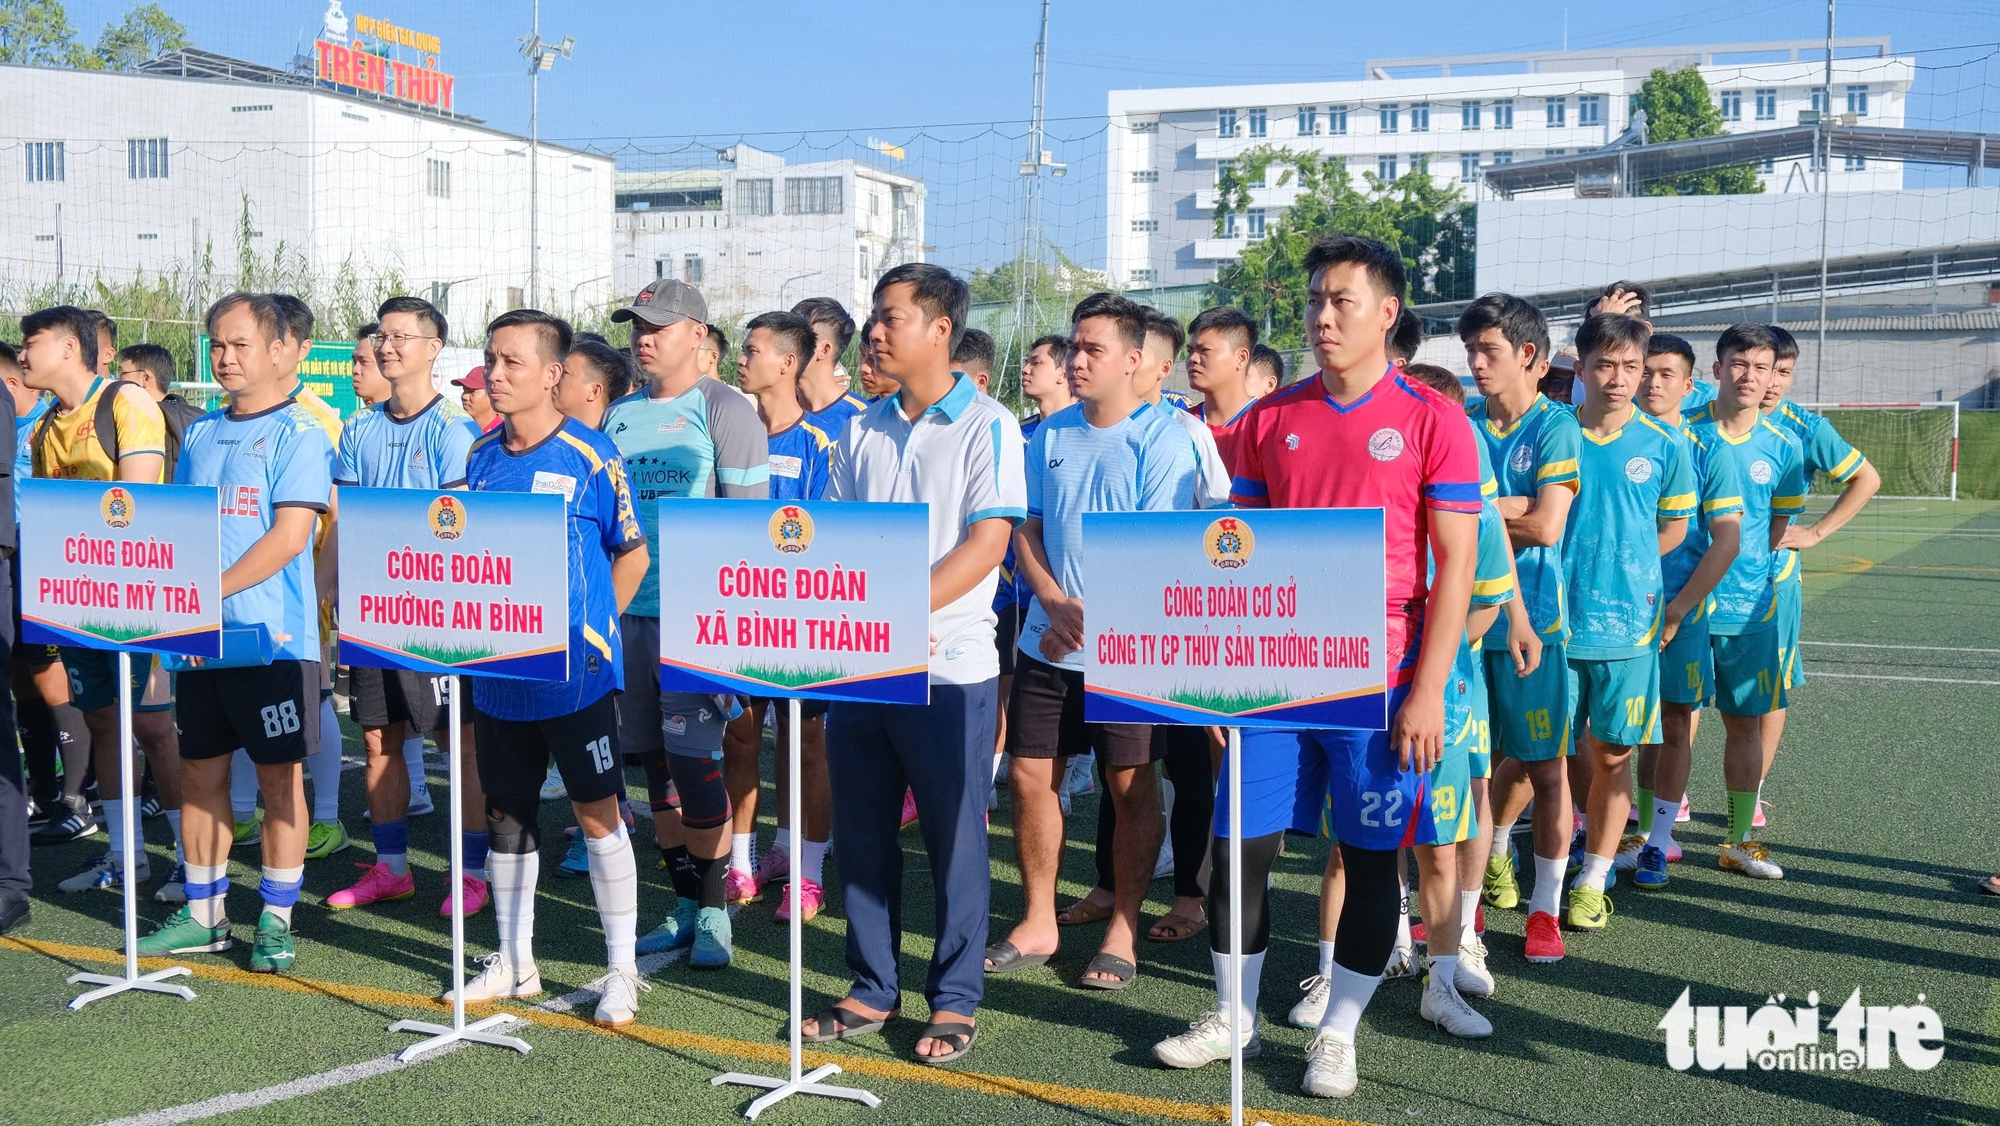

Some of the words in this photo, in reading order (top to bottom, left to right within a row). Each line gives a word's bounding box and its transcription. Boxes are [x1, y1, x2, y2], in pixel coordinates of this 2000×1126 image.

[355, 14, 375, 36] NPP
[399, 27, 415, 48] GIA
[316, 39, 386, 94] TRÊN
[391, 56, 455, 110] THỦY
[641, 470, 691, 485] WORK
[65, 533, 115, 566] CÔNG
[121, 537, 174, 570] ĐOÀN
[387, 546, 444, 582] CÔNG
[451, 550, 512, 585] ĐOÀN
[39, 574, 119, 608] PHƯỜNG
[126, 580, 156, 611] MỸ
[162, 582, 201, 615] TRÀ
[718, 560, 787, 599] CÔNG
[795, 563, 866, 601] ĐOÀN
[1164, 580, 1202, 617] CÔNG
[1207, 580, 1248, 617] ĐOÀN
[1252, 582, 1272, 618] CƠ
[1276, 575, 1297, 618] SỞ
[360, 591, 444, 628] PHƯỜNG
[452, 601, 482, 630] AN
[489, 598, 543, 634] BÌNH
[695, 609, 729, 646] XÃ
[737, 611, 797, 648] BÌNH
[805, 614, 890, 653] THÀNH
[1097, 628, 1136, 665] CÔNG
[1141, 634, 1156, 665] TY
[1161, 635, 1180, 666] CP
[1184, 625, 1219, 667] THỦY
[1224, 625, 1255, 667] SẢN
[1259, 628, 1318, 668] TRƯỜNG
[1323, 636, 1370, 669] GIANG
[1757, 668, 1772, 696] 11
[261, 700, 300, 738] 88
[1525, 708, 1551, 741] 19
[1626, 696, 1645, 727] 10
[586, 735, 614, 774] 19
[1361, 789, 1402, 828] 22
